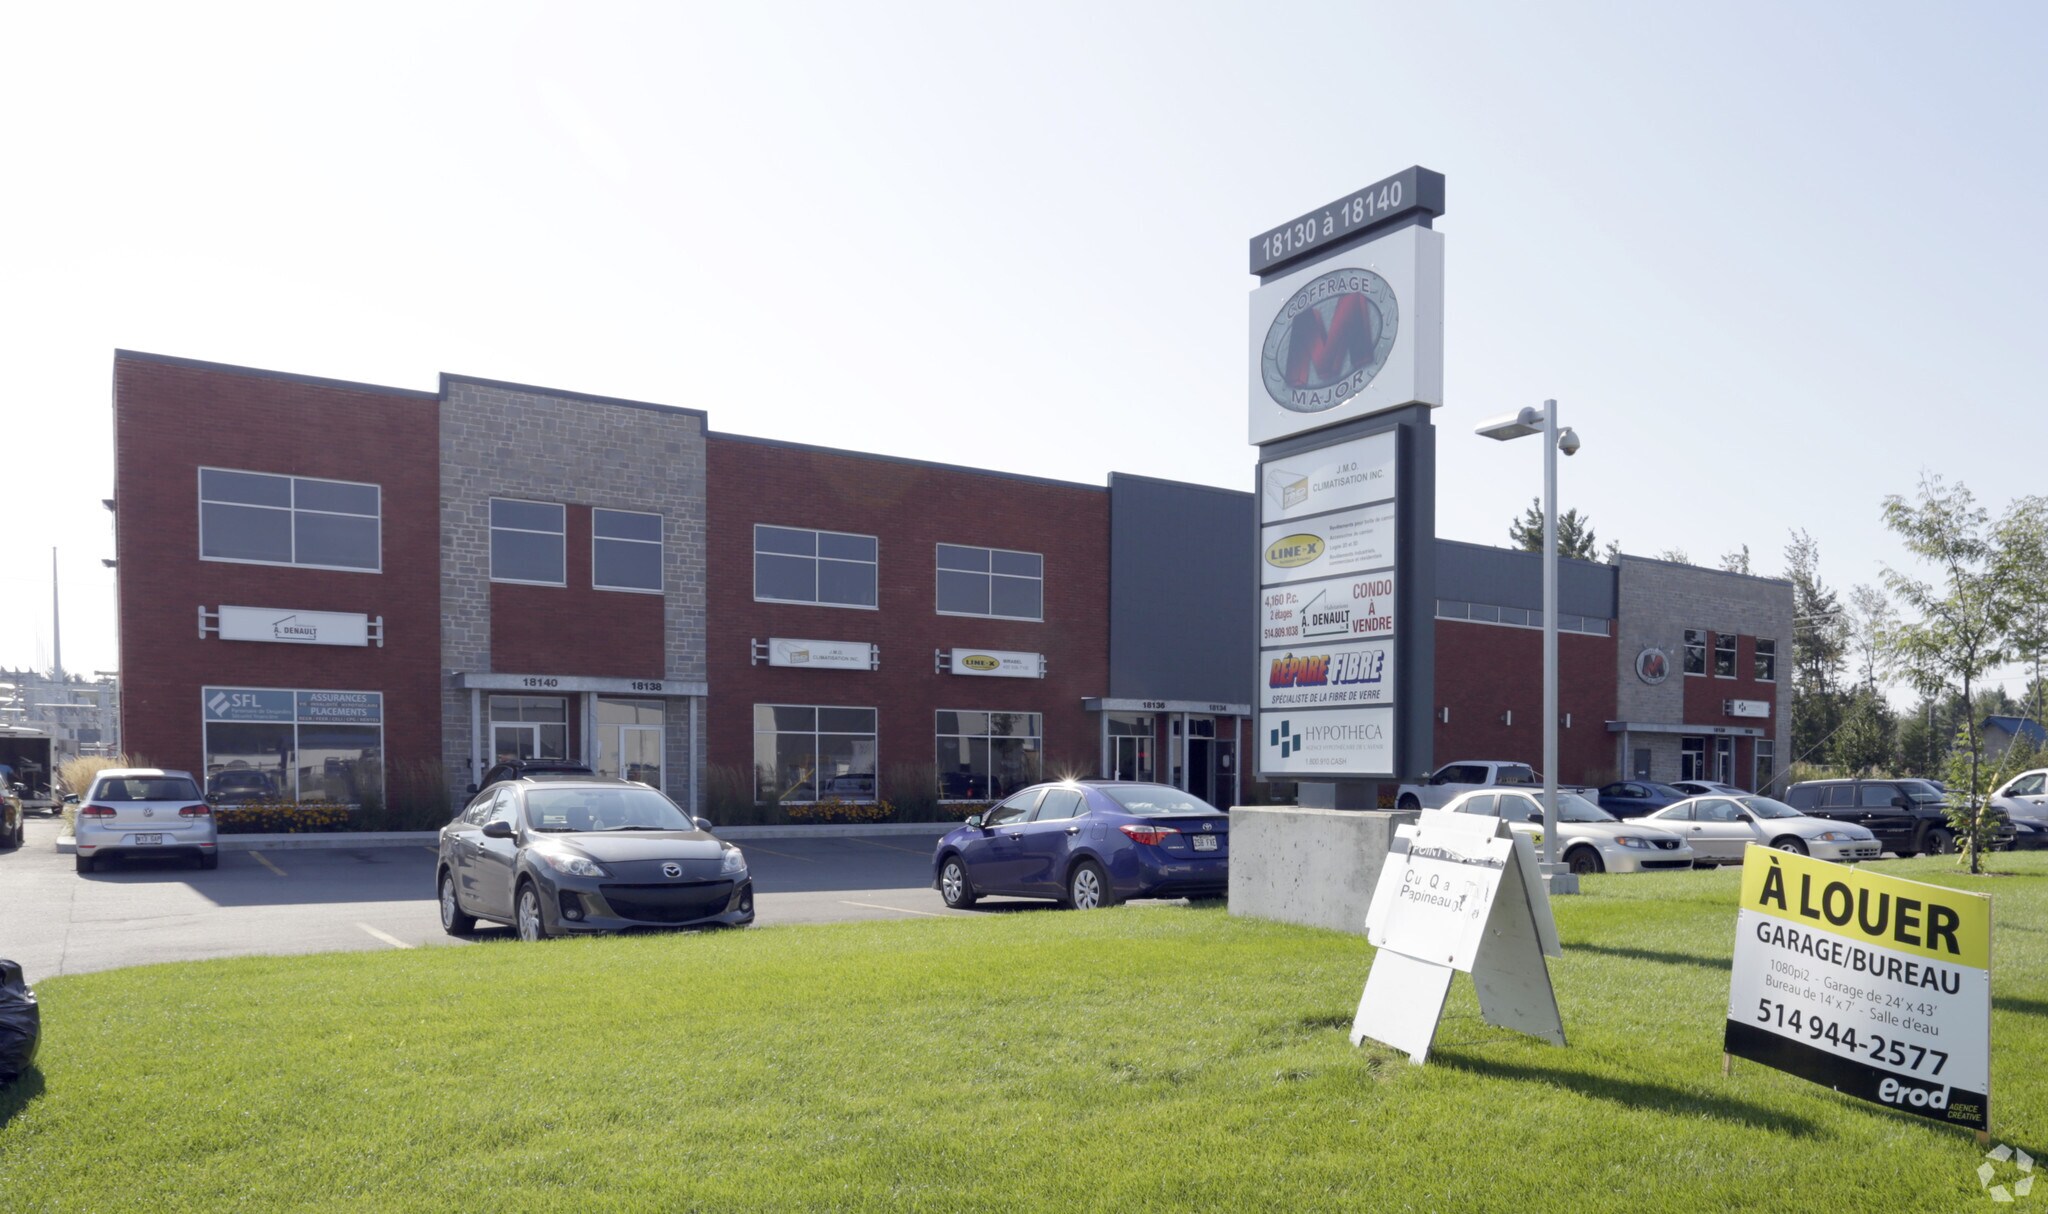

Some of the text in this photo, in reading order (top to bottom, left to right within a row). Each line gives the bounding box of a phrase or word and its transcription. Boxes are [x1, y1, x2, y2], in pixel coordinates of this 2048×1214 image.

[1262, 181, 1402, 260] 18130 à 18140
[1287, 276, 1370, 320] COFFRAGE
[1292, 369, 1364, 406] MAJOR
[1312, 474, 1368, 493] CLIMATISATION
[1271, 543, 1317, 561] LINE-X
[1353, 579, 1392, 599] CONDO
[1264, 594, 1284, 608] 4,160
[1368, 599, 1375, 616] À
[1270, 608, 1293, 621] 2 étages
[1312, 610, 1350, 626] DENAULT
[284, 627, 317, 635] DENAULT
[1264, 625, 1299, 639] 514.809.1038
[1352, 616, 1392, 633] VENDRE
[1269, 650, 1385, 689] RÉPARE FIBRE
[522, 678, 558, 687] 18140
[631, 681, 662, 691] 18138
[231, 693, 262, 708] SFL
[310, 693, 367, 703] ASSURANCES
[1271, 689, 1381, 704] SPÉCIALISTE DE LA FIBRE DE VERRE
[310, 707, 367, 716] PLACEMENTS
[1305, 724, 1383, 741] HYPOTHECA
[1759, 855, 1961, 955] À LOUER
[1756, 921, 1960, 995] GARAGE/BUREAU
[1770, 959, 1810, 982] 1080pi2
[1824, 976, 1863, 1000] Garage
[1867, 988, 1882, 1004] de
[1906, 1002, 1914, 1012] x
[1765, 974, 1801, 995] Bureau
[1803, 986, 1816, 1001] de
[1836, 1000, 1842, 1010] x
[1870, 1007, 1898, 1027] Salle
[1902, 1017, 1939, 1036] d'eau
[1757, 998, 1949, 1076] 514 944-2577
[1878, 1077, 1951, 1110] erod
[1948, 1103, 1979, 1113] AGENCE
